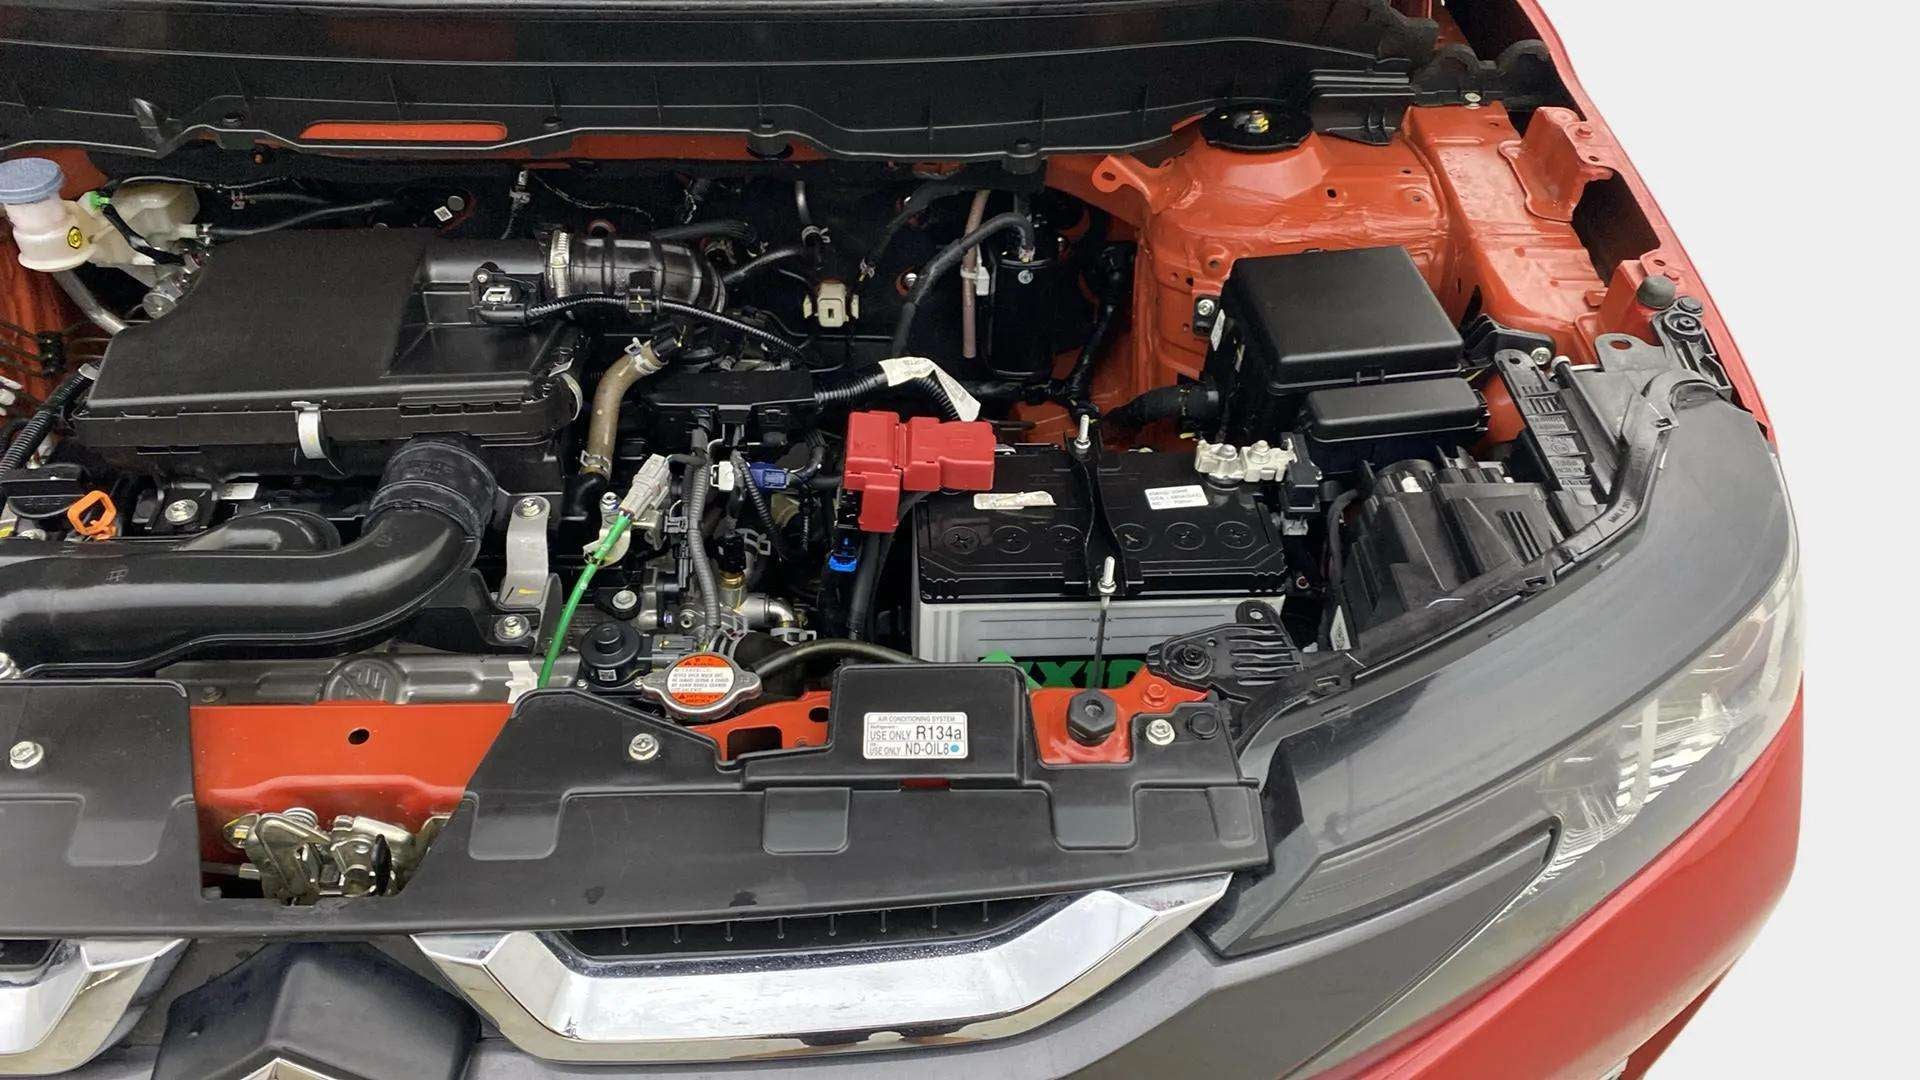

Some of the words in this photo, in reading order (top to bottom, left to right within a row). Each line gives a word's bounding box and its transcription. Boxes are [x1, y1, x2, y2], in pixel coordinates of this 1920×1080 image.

[870, 730, 887, 740] USE
[889, 730, 911, 740] ONLY
[916, 725, 961, 740] R134a
[869, 747, 883, 756] USE
[884, 746, 901, 755] ONLY
[905, 742, 950, 755] ND-OIL8
